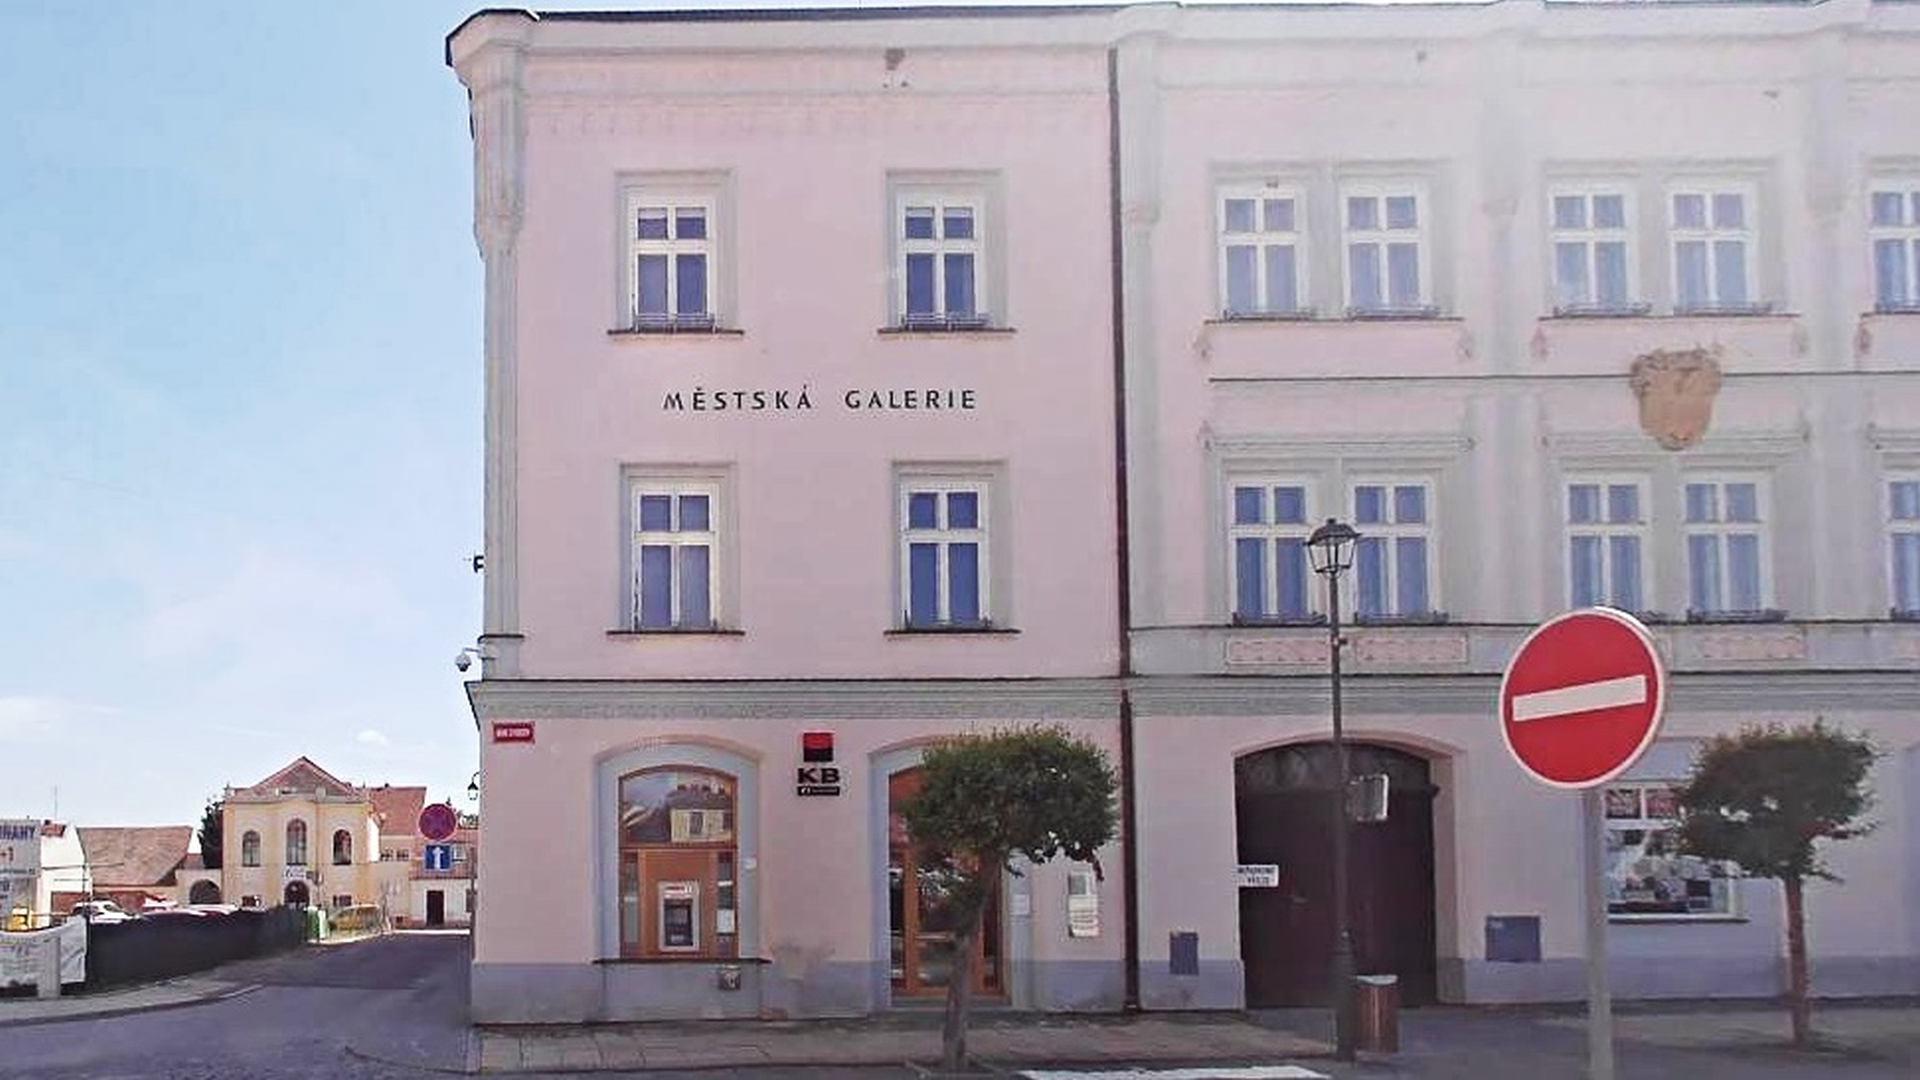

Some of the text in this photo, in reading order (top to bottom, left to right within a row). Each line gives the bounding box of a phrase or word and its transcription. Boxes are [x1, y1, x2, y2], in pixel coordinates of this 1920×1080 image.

[663, 385, 976, 410] MĚSTSKÁ GALERIE
[797, 767, 841, 784] KB
